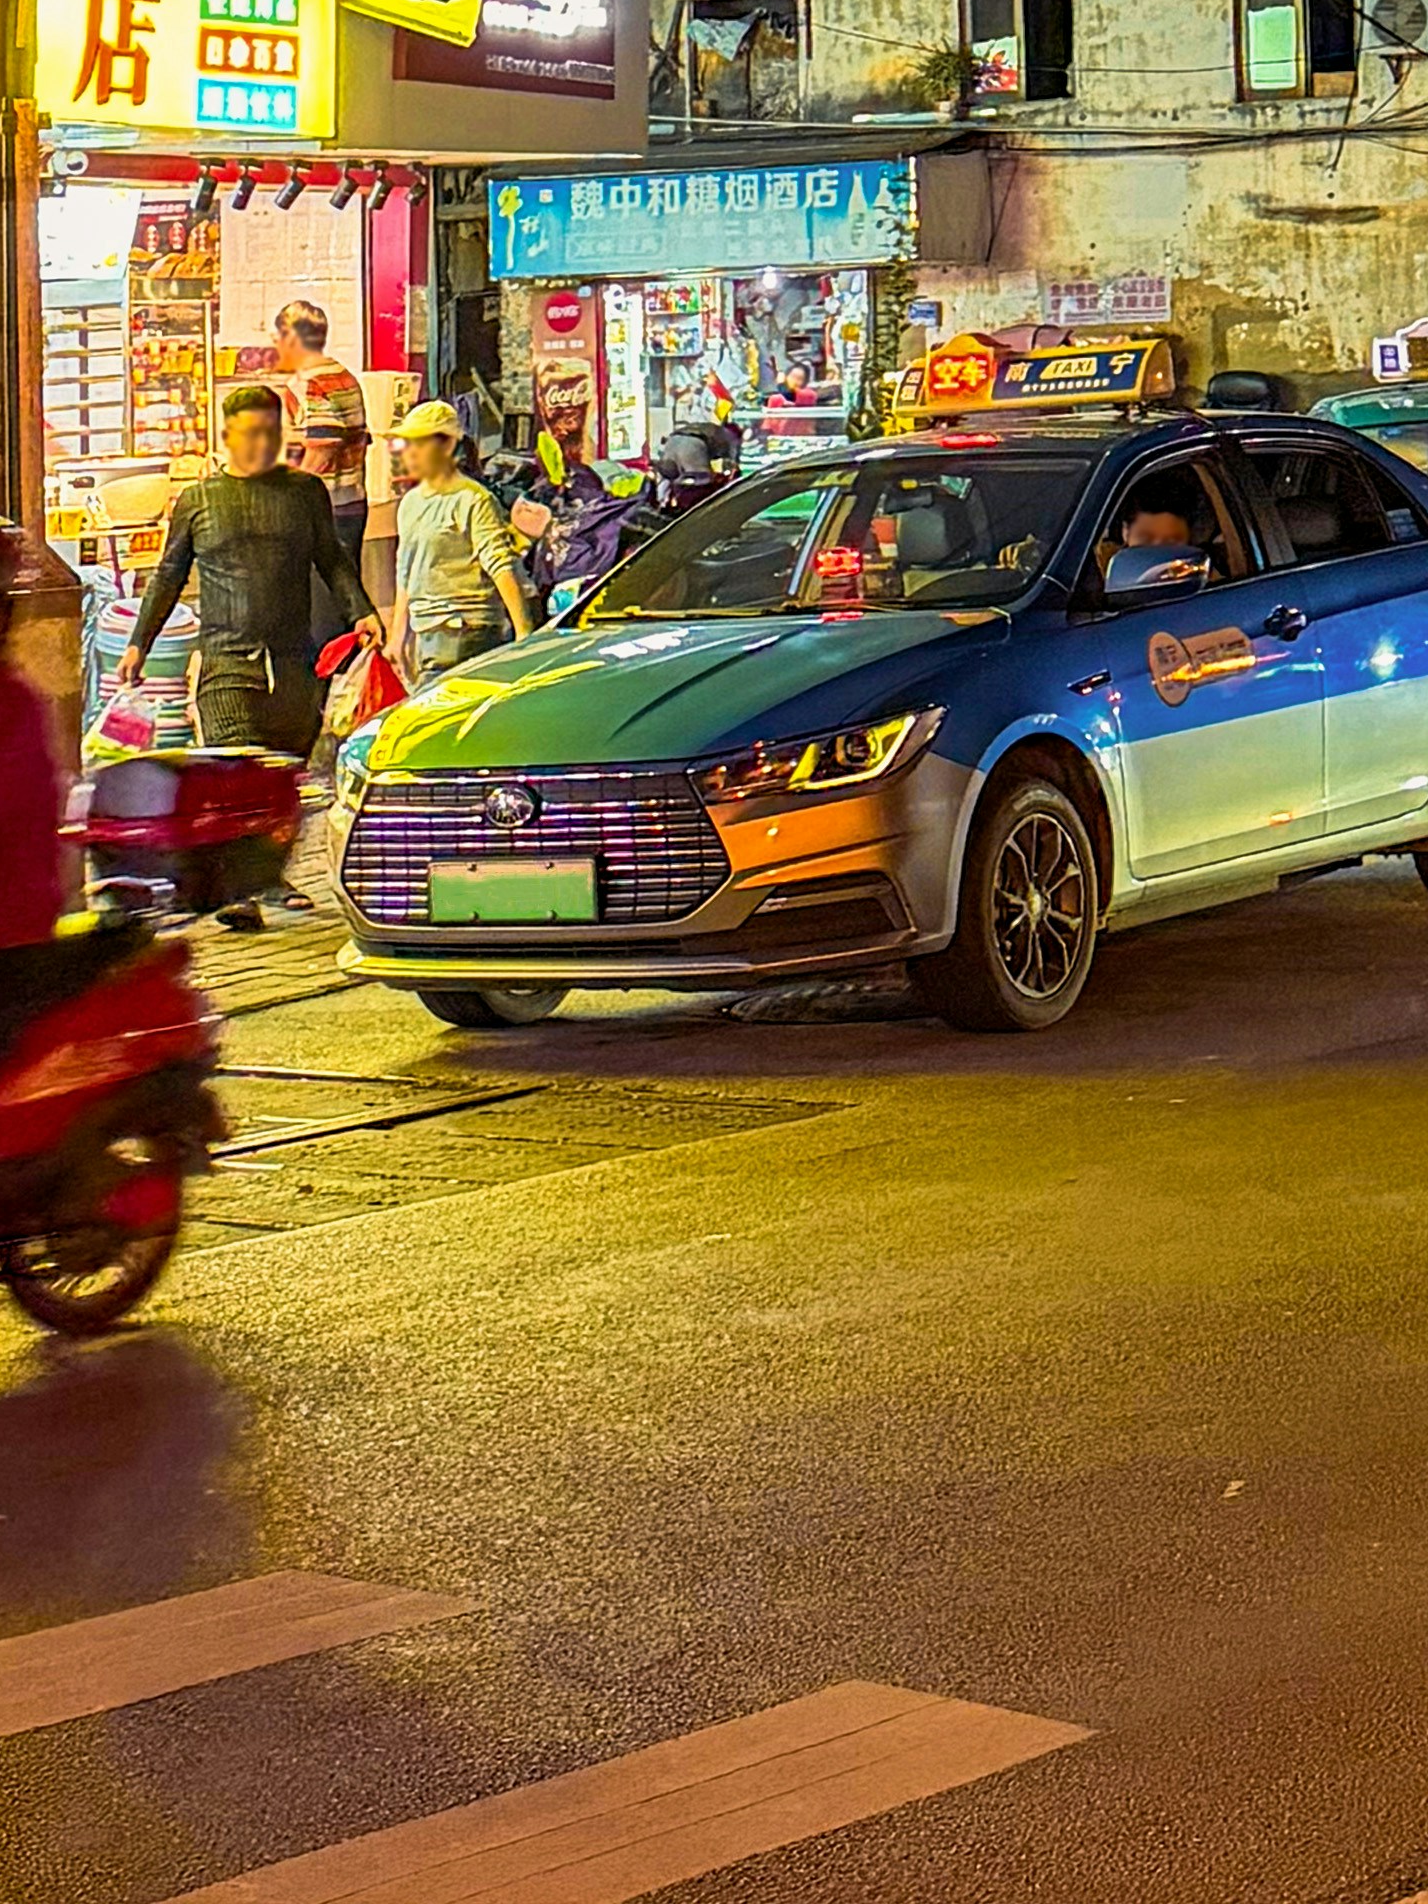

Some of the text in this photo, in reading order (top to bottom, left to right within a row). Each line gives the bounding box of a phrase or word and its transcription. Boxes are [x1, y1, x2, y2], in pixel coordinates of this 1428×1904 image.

[570, 168, 840, 220] 魏中和糖烟酒店
[933, 356, 988, 390] 空车
[1052, 359, 1093, 374] TAXI
[1108, 353, 1136, 375] 宁
